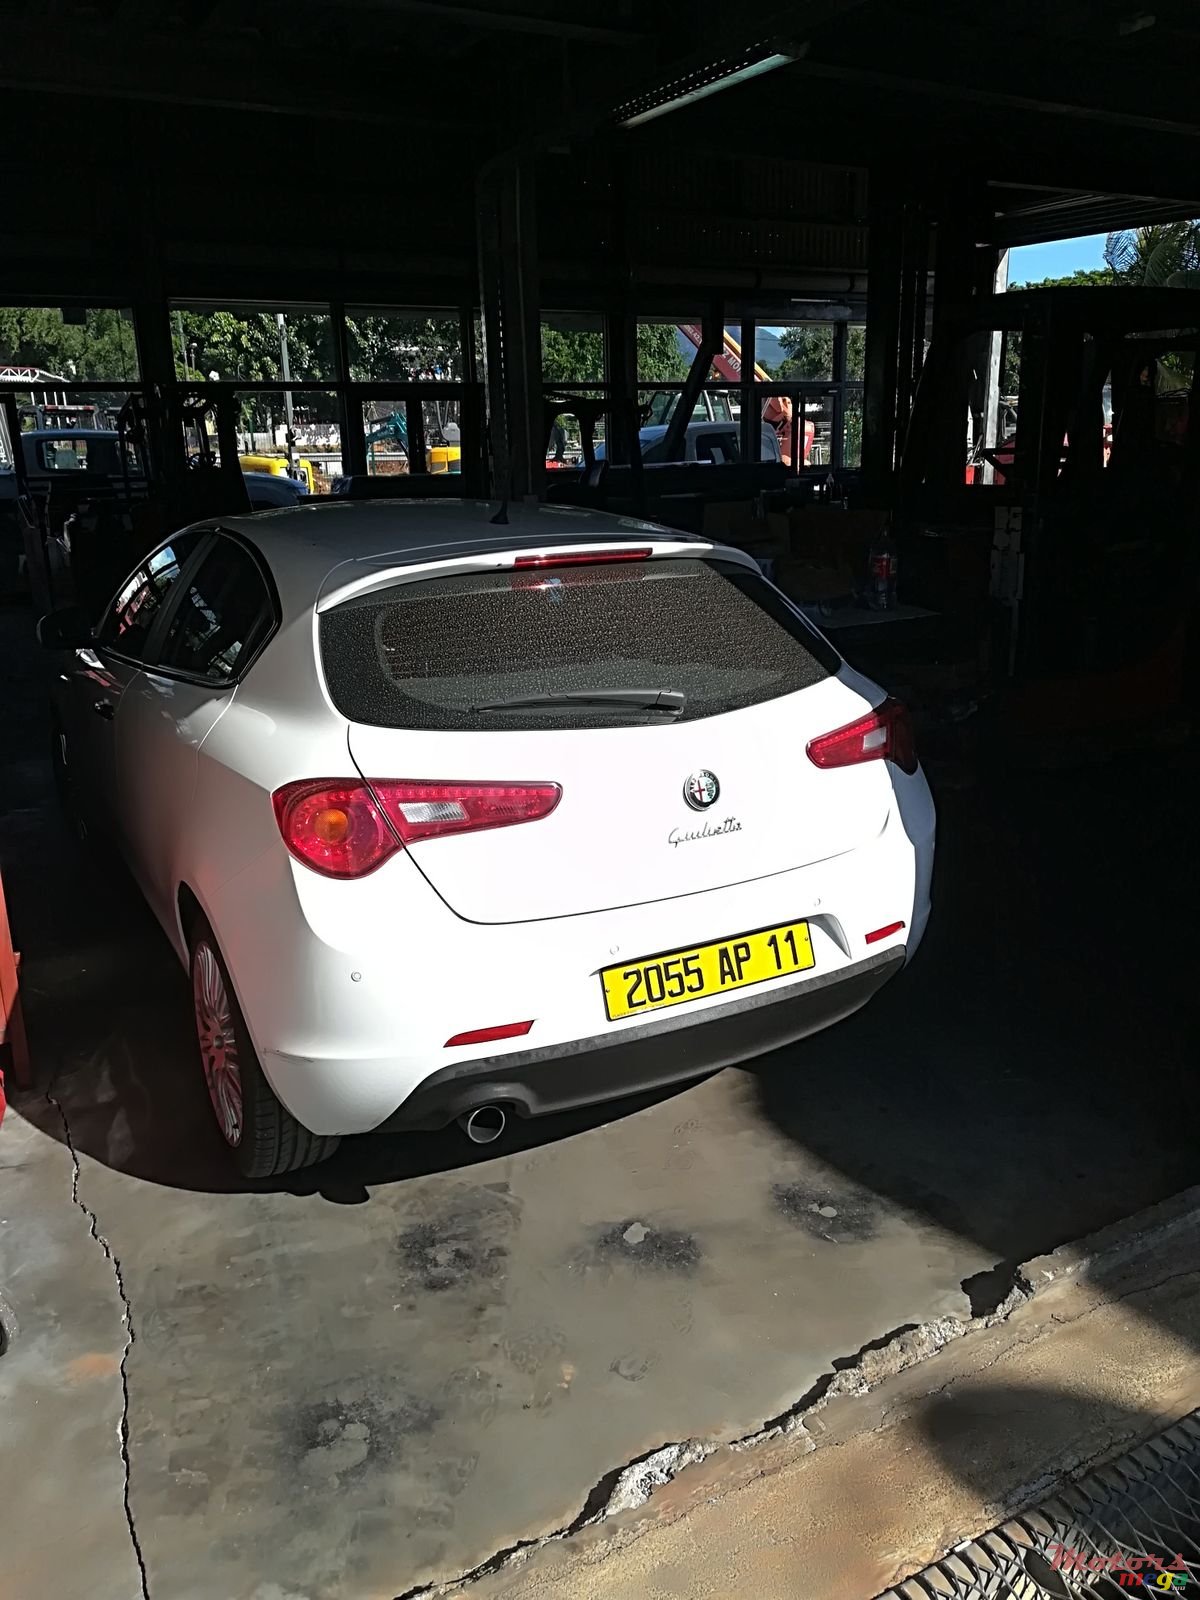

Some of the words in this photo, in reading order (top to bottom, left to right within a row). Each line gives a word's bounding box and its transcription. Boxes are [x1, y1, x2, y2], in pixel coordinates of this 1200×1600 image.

[623, 954, 704, 1009] 2055
[718, 941, 751, 985] AP
[767, 930, 799, 970] 11
